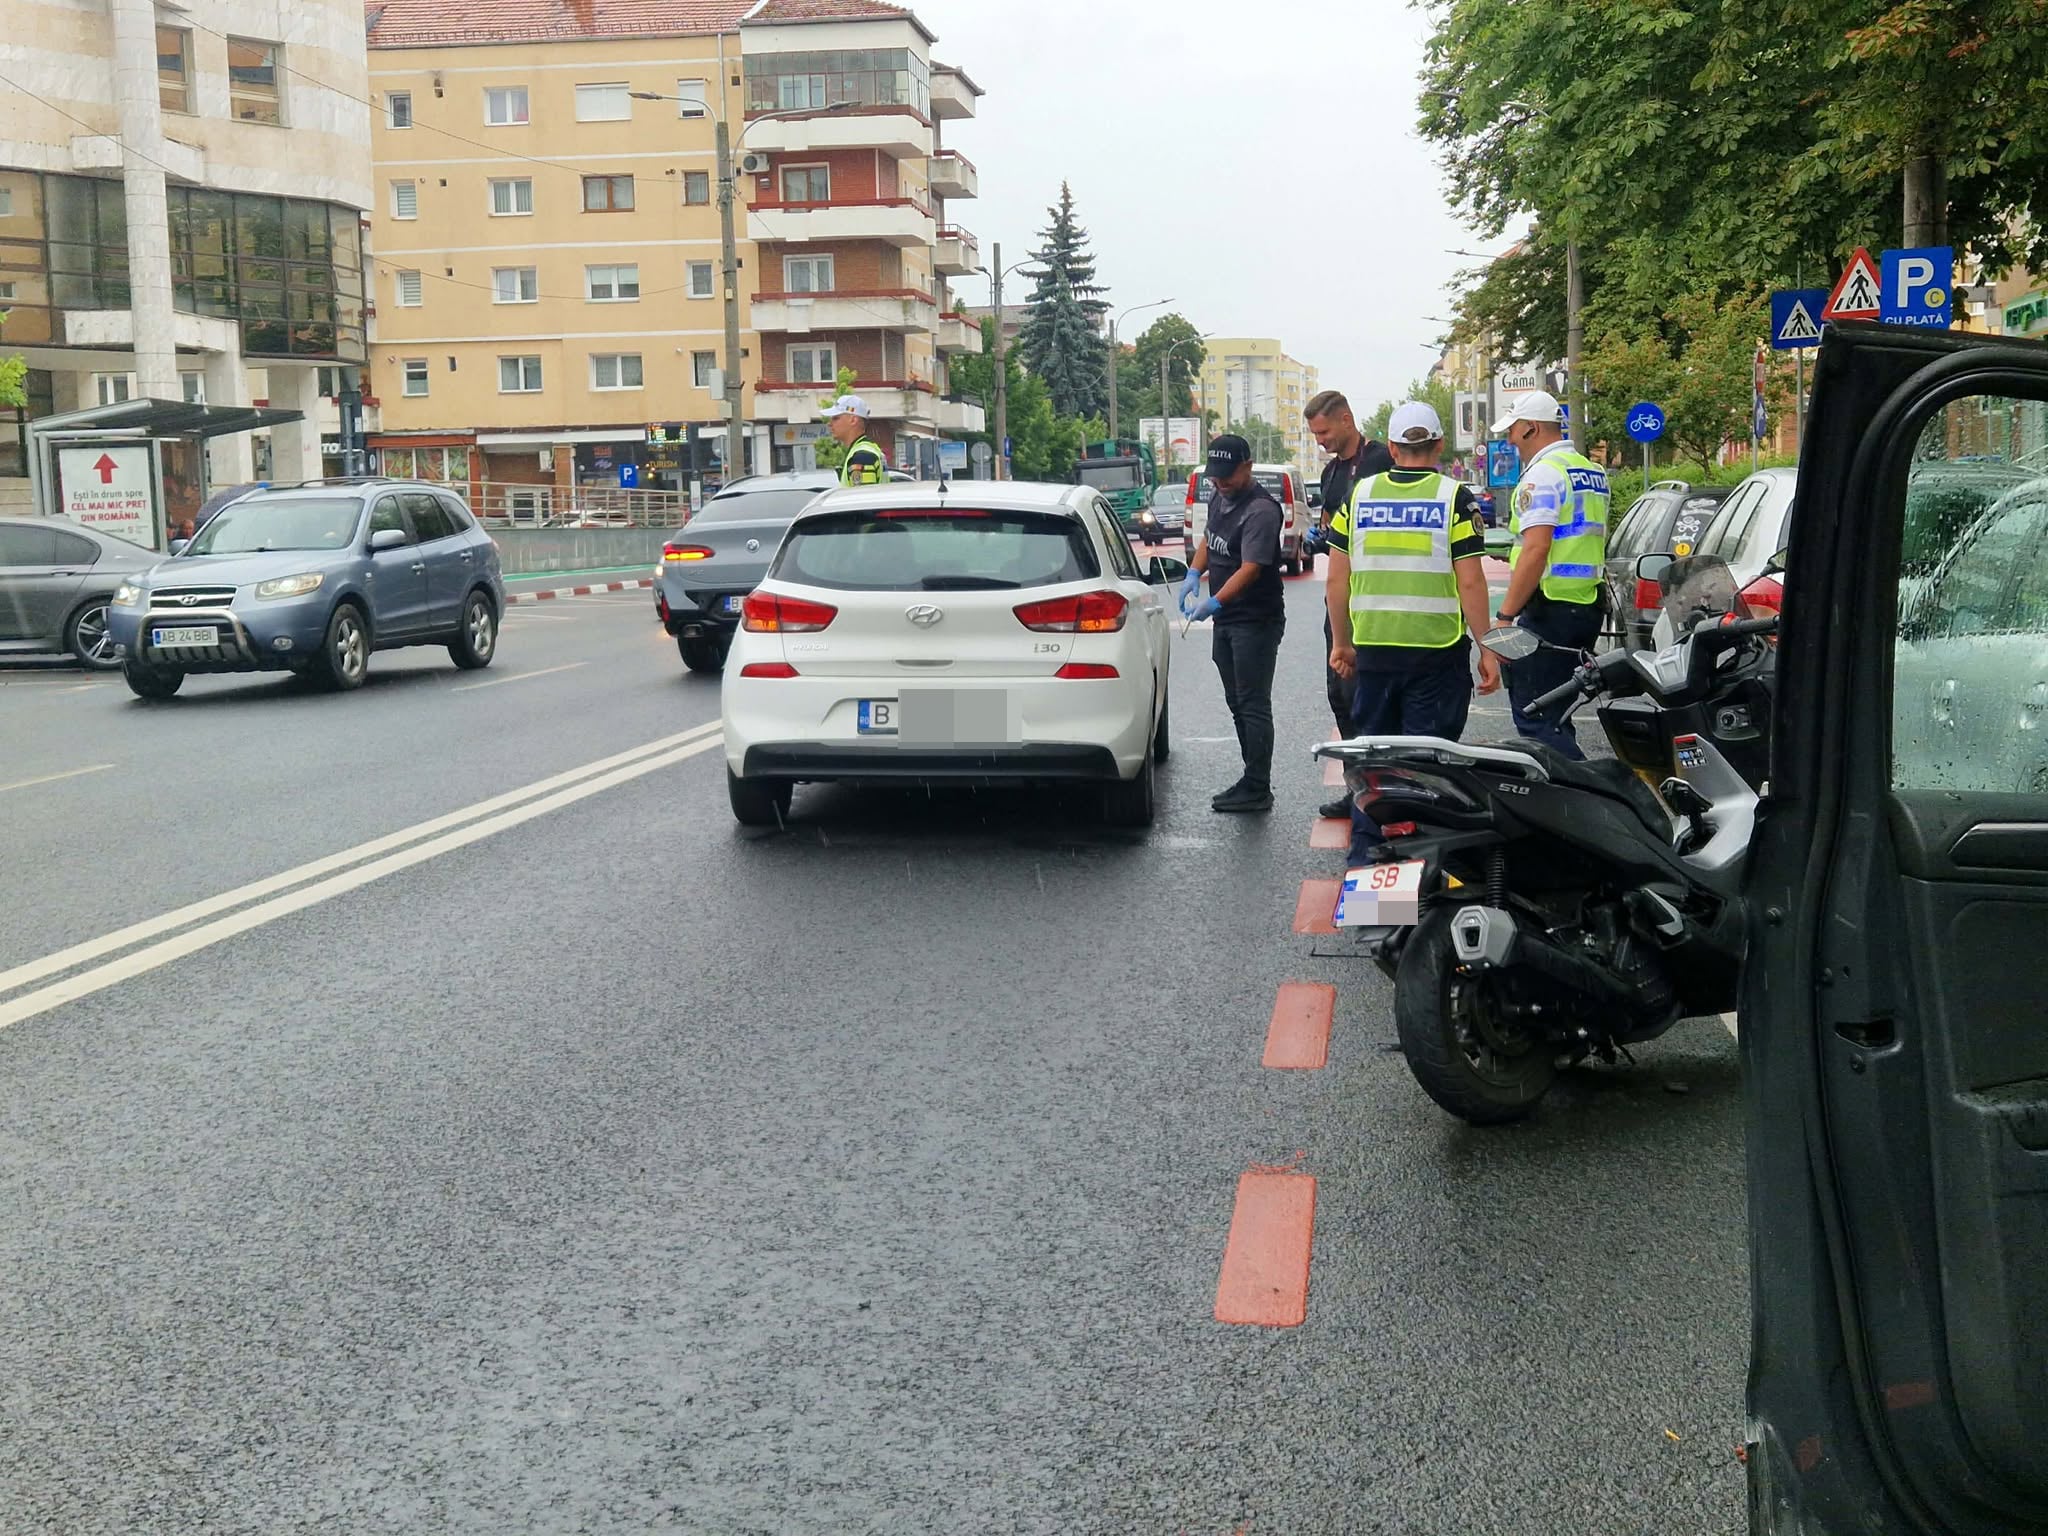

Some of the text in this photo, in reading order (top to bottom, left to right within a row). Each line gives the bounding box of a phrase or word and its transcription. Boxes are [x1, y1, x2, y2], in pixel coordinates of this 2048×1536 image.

[1897, 257, 1935, 309] P
[623, 467, 633, 481] P
[101, 489, 123, 499] drum
[125, 489, 144, 499] spre
[71, 502, 87, 511] CEL
[88, 501, 105, 510] MAI
[107, 500, 124, 509] MIC
[1358, 506, 1443, 524] POLITIA
[162, 631, 175, 642] AB
[179, 631, 192, 641] 24
[875, 704, 890, 725] B
[1371, 865, 1400, 890] SB
